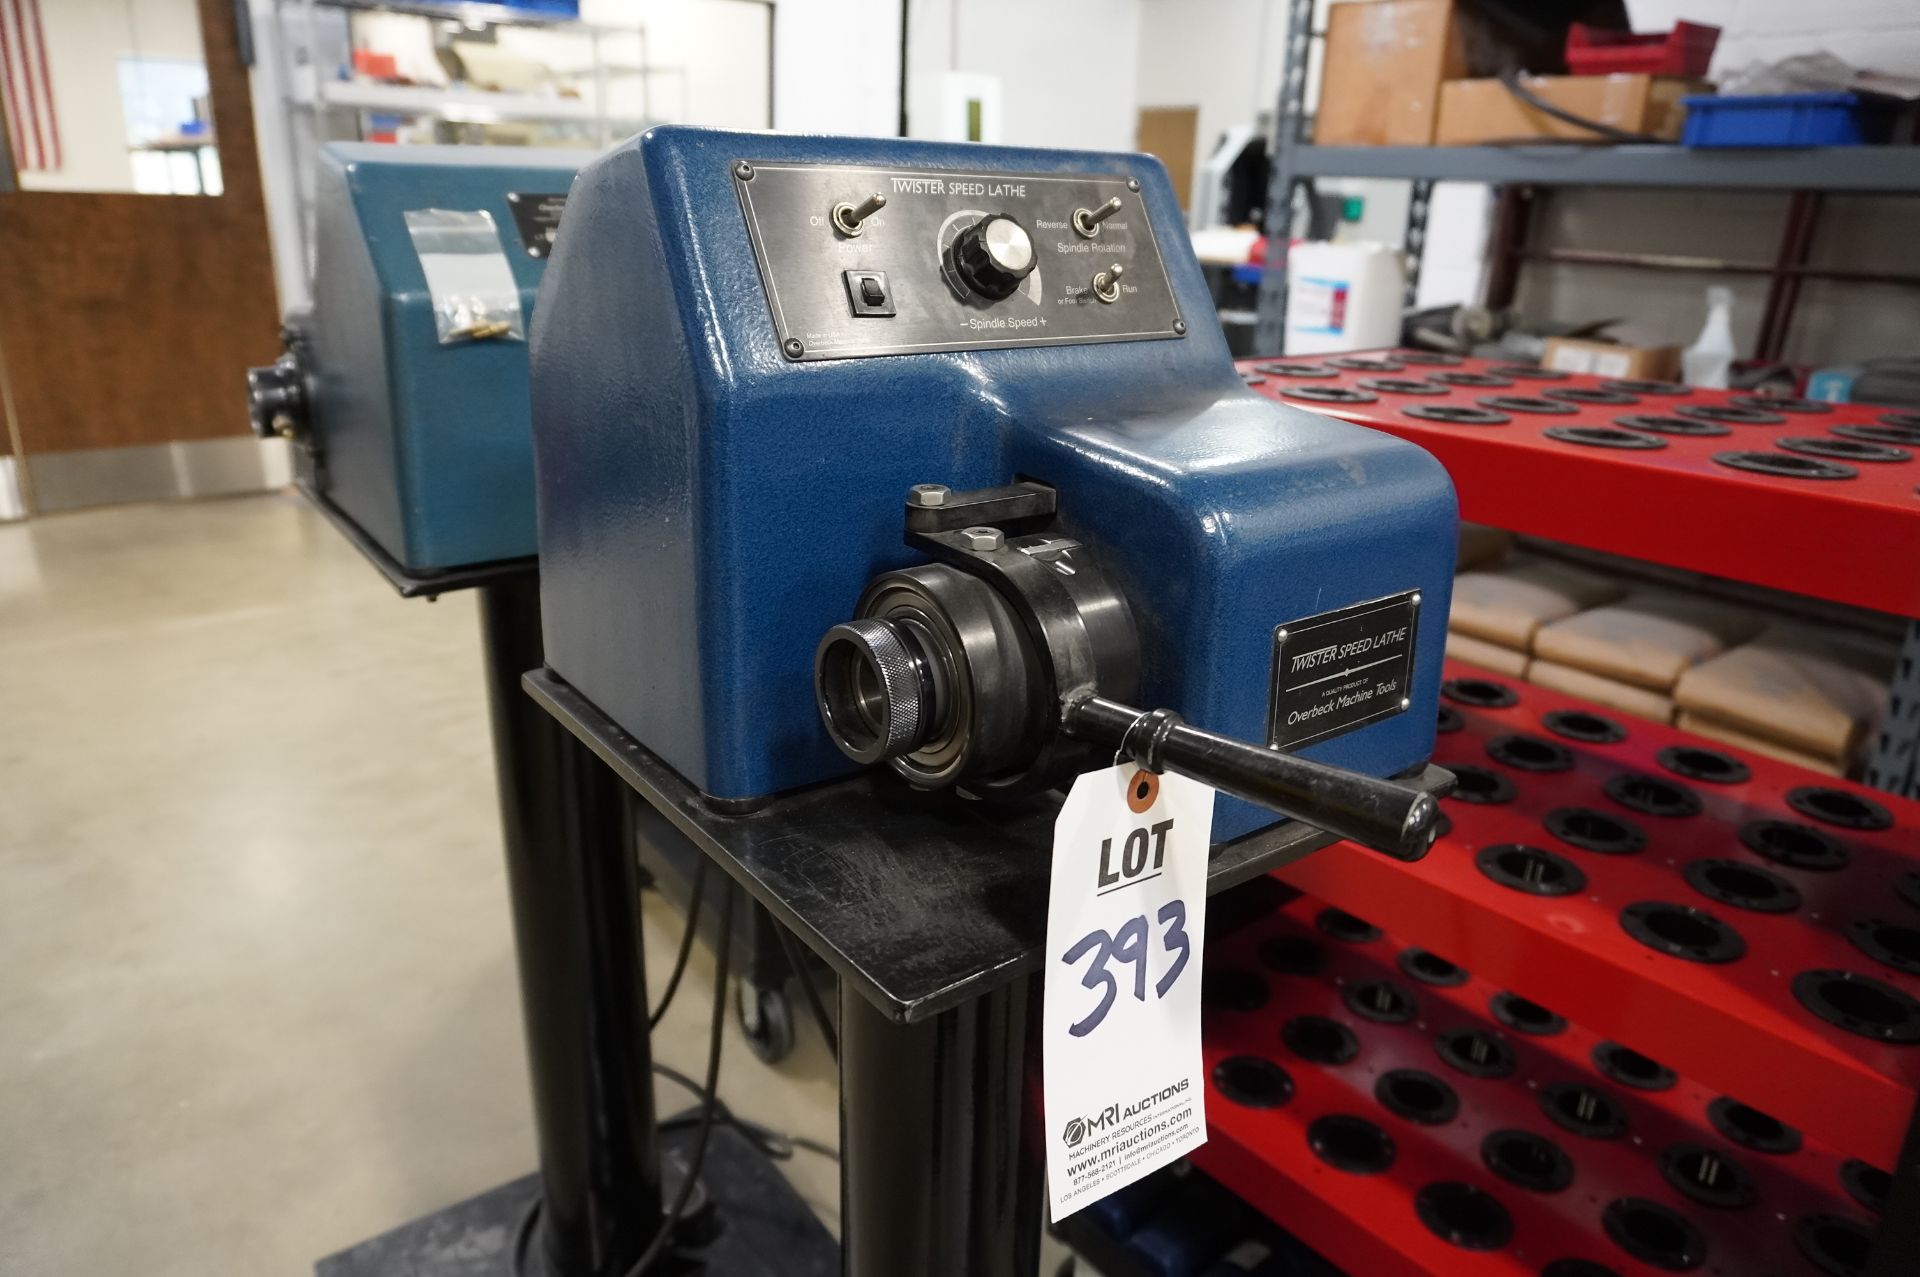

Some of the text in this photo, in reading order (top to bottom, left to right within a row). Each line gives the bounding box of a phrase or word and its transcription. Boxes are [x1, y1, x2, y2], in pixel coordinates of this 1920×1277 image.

[891, 178, 1026, 197] TWISTER SPEED LATHE
[810, 216, 884, 226] Off On
[1036, 219, 1068, 229] Reverse
[839, 243, 873, 253] Power
[1057, 242, 1126, 254] Spindle Rotation
[1066, 284, 1137, 295] Brake Run
[1008, 317, 1038, 329] Speed
[1290, 627, 1407, 673] TWISTER SPEED LATHE
[1325, 686, 1343, 696] QUALITY
[1343, 679, 1363, 691] PRODUCT
[1287, 678, 1397, 725] Overbeck Machine Tools
[1097, 818, 1174, 889] LOT
[1062, 899, 1190, 1038] 393
[1087, 1078, 1189, 1137] MRI AUCTIONS
[1067, 1106, 1192, 1177] www.mriauctions.com
[1068, 1135, 1111, 1161] MACHINERY
[1112, 1114, 1153, 1140] RESOURCES
[1060, 1126, 1200, 1204] LOS ANGELES SCOTTSDALE CHICAGO TORONTO
[1073, 1160, 1117, 1186] 877-568-2121
